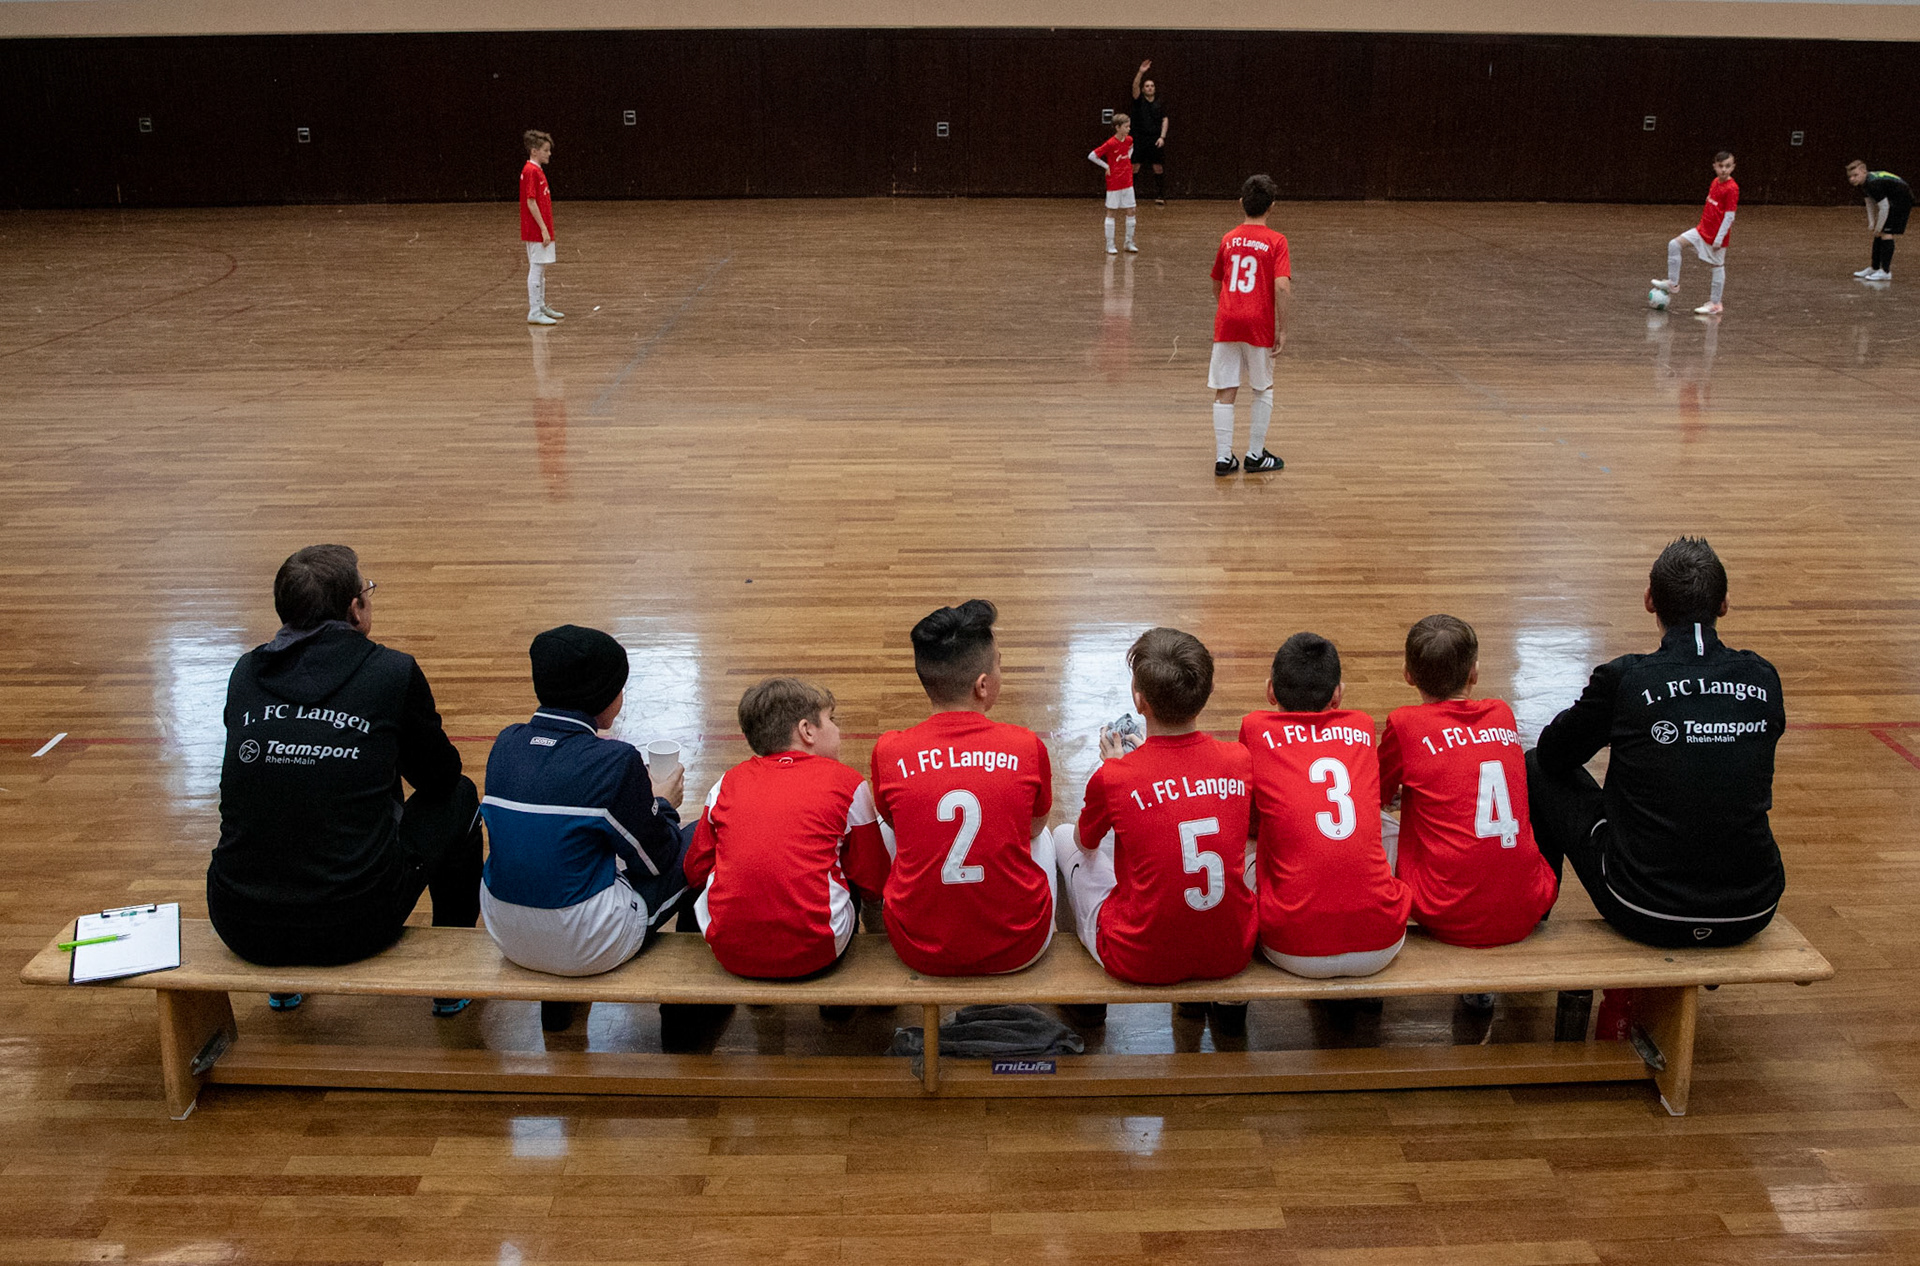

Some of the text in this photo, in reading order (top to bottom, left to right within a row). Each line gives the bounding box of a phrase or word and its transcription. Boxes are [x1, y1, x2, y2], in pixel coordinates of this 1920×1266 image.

[1232, 237, 1242, 247] FC
[1243, 237, 1269, 252] Langen
[1229, 254, 1257, 294] 13
[1641, 678, 1767, 706] 1. FC Langen
[242, 704, 372, 734] 1. FC Langen
[1683, 719, 1767, 736] Teamsport
[266, 740, 360, 760] Teamsport
[1262, 724, 1371, 749] 1. FC Langen
[1422, 736, 1443, 755] 1.
[1442, 727, 1467, 749] FC
[1686, 735, 1735, 743] Rhein-Main
[265, 755, 316, 765] Rhein-Main
[897, 747, 1019, 778] 1. FC Langen
[1130, 776, 1245, 811] 1. FC Langen
[1309, 757, 1357, 840] 3
[1475, 760, 1519, 849] 4
[937, 789, 985, 885] 2
[1178, 816, 1225, 911] 5
